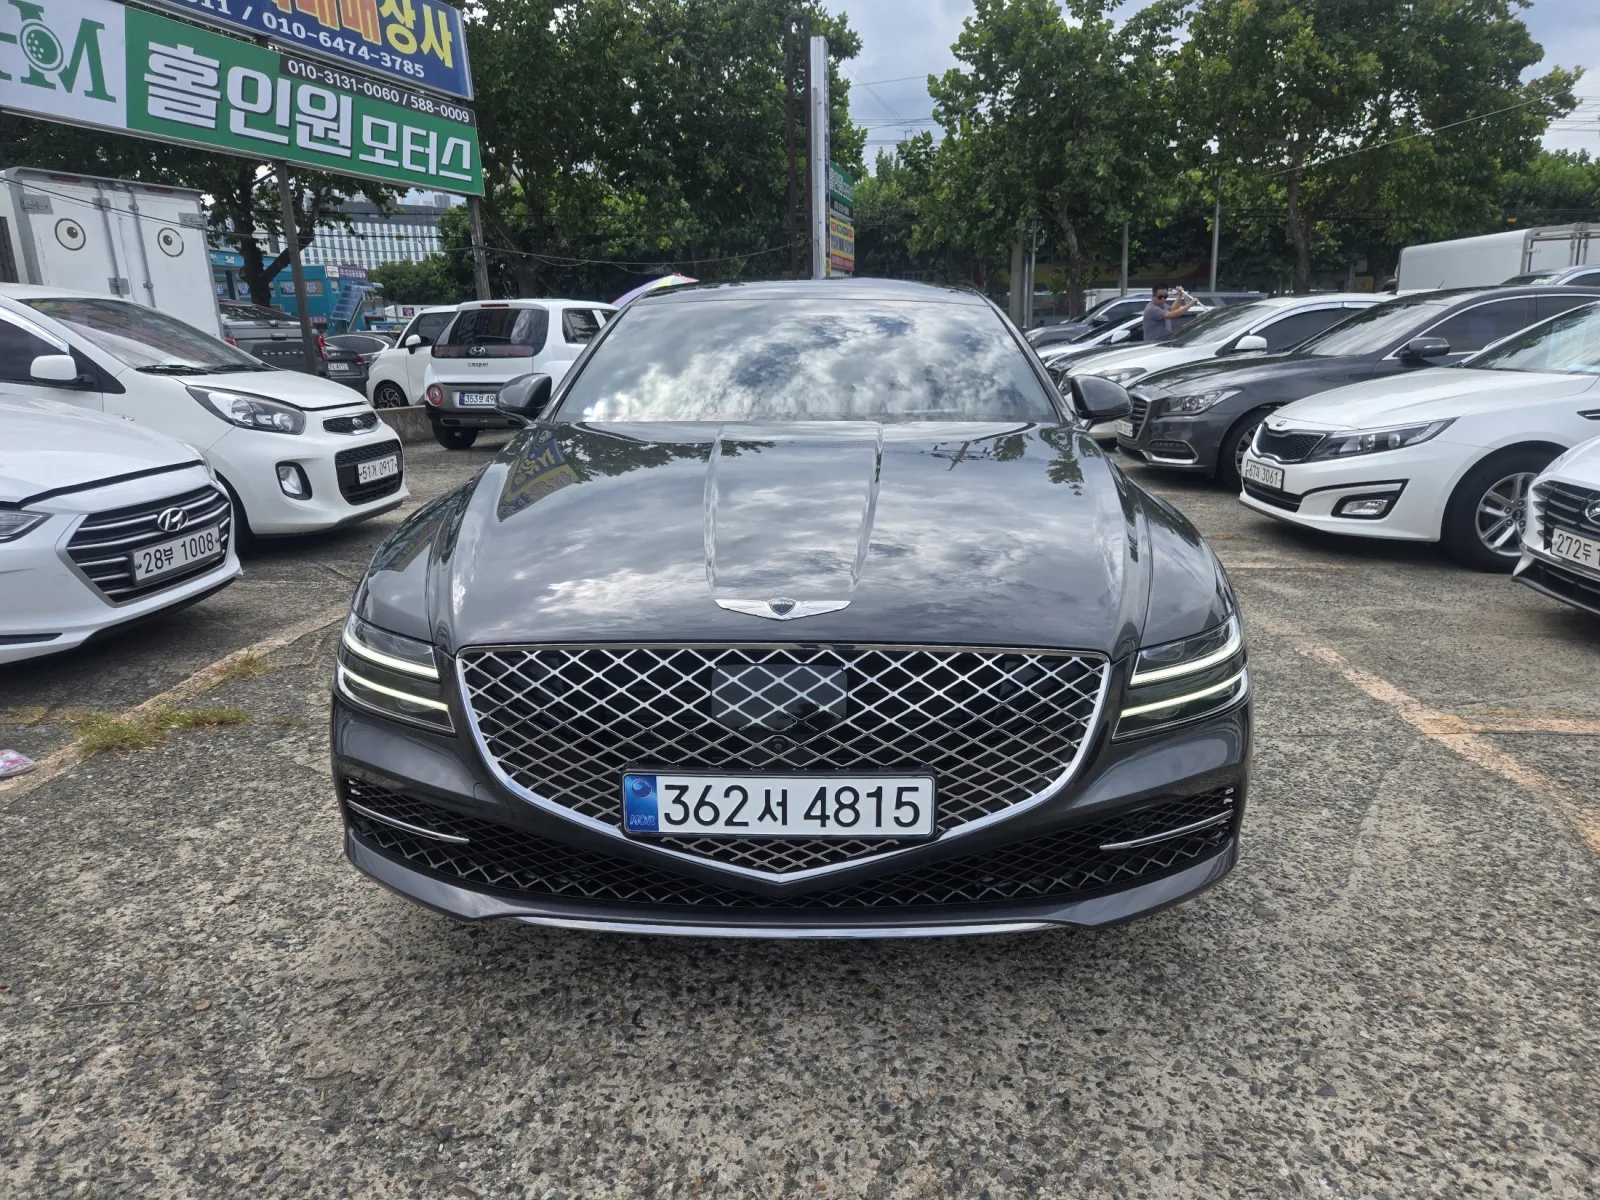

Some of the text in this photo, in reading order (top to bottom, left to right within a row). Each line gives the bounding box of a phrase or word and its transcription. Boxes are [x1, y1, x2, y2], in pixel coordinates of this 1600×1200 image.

[262, 12, 425, 78] 010-6474-3785
[288, 59, 399, 104] 010-3131-0060
[411, 96, 470, 124] 588-0009
[1261, 468, 1279, 486] 3061
[143, 532, 214, 575] 28부 1008
[629, 814, 656, 826] KOR
[663, 784, 921, 828] 362서 4815
